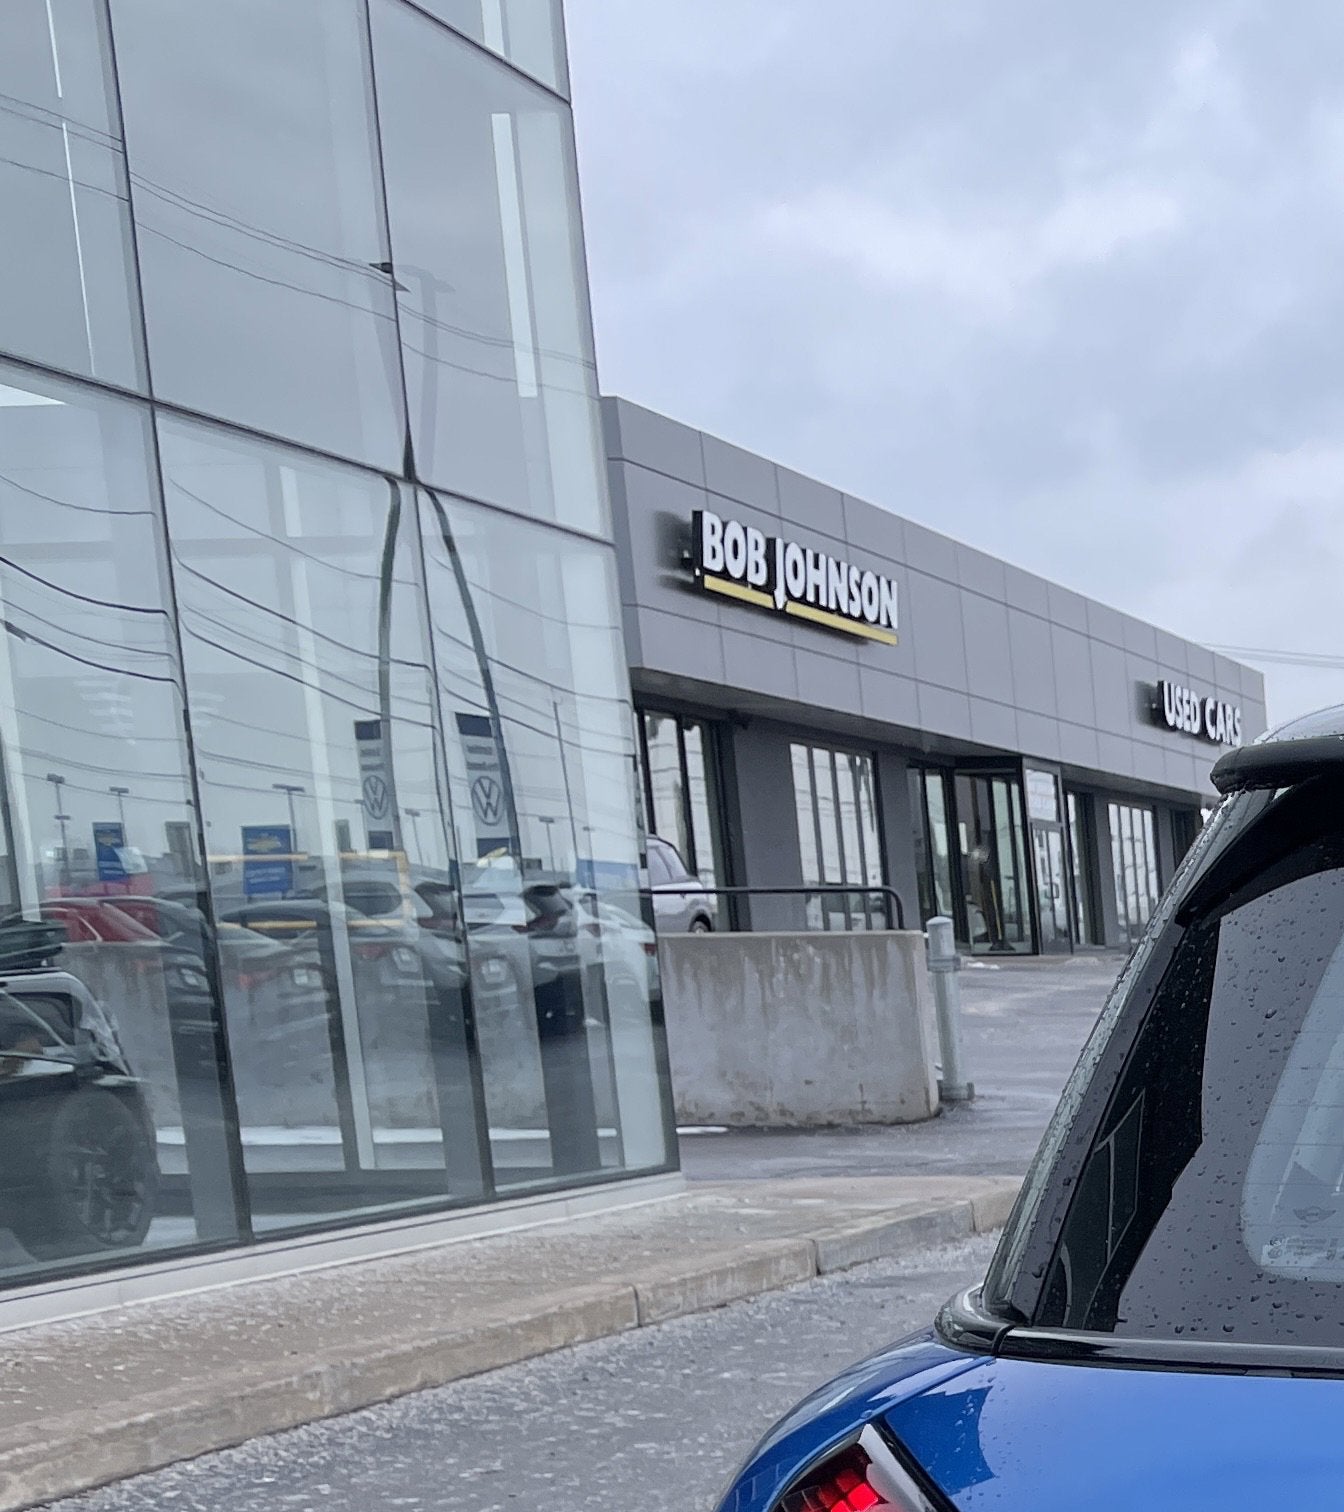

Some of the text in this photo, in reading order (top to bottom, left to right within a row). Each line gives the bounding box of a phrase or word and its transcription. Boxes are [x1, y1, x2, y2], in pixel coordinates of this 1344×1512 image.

[702, 510, 899, 630] BOB JOHNSON
[1162, 679, 1242, 747] USED CARS
